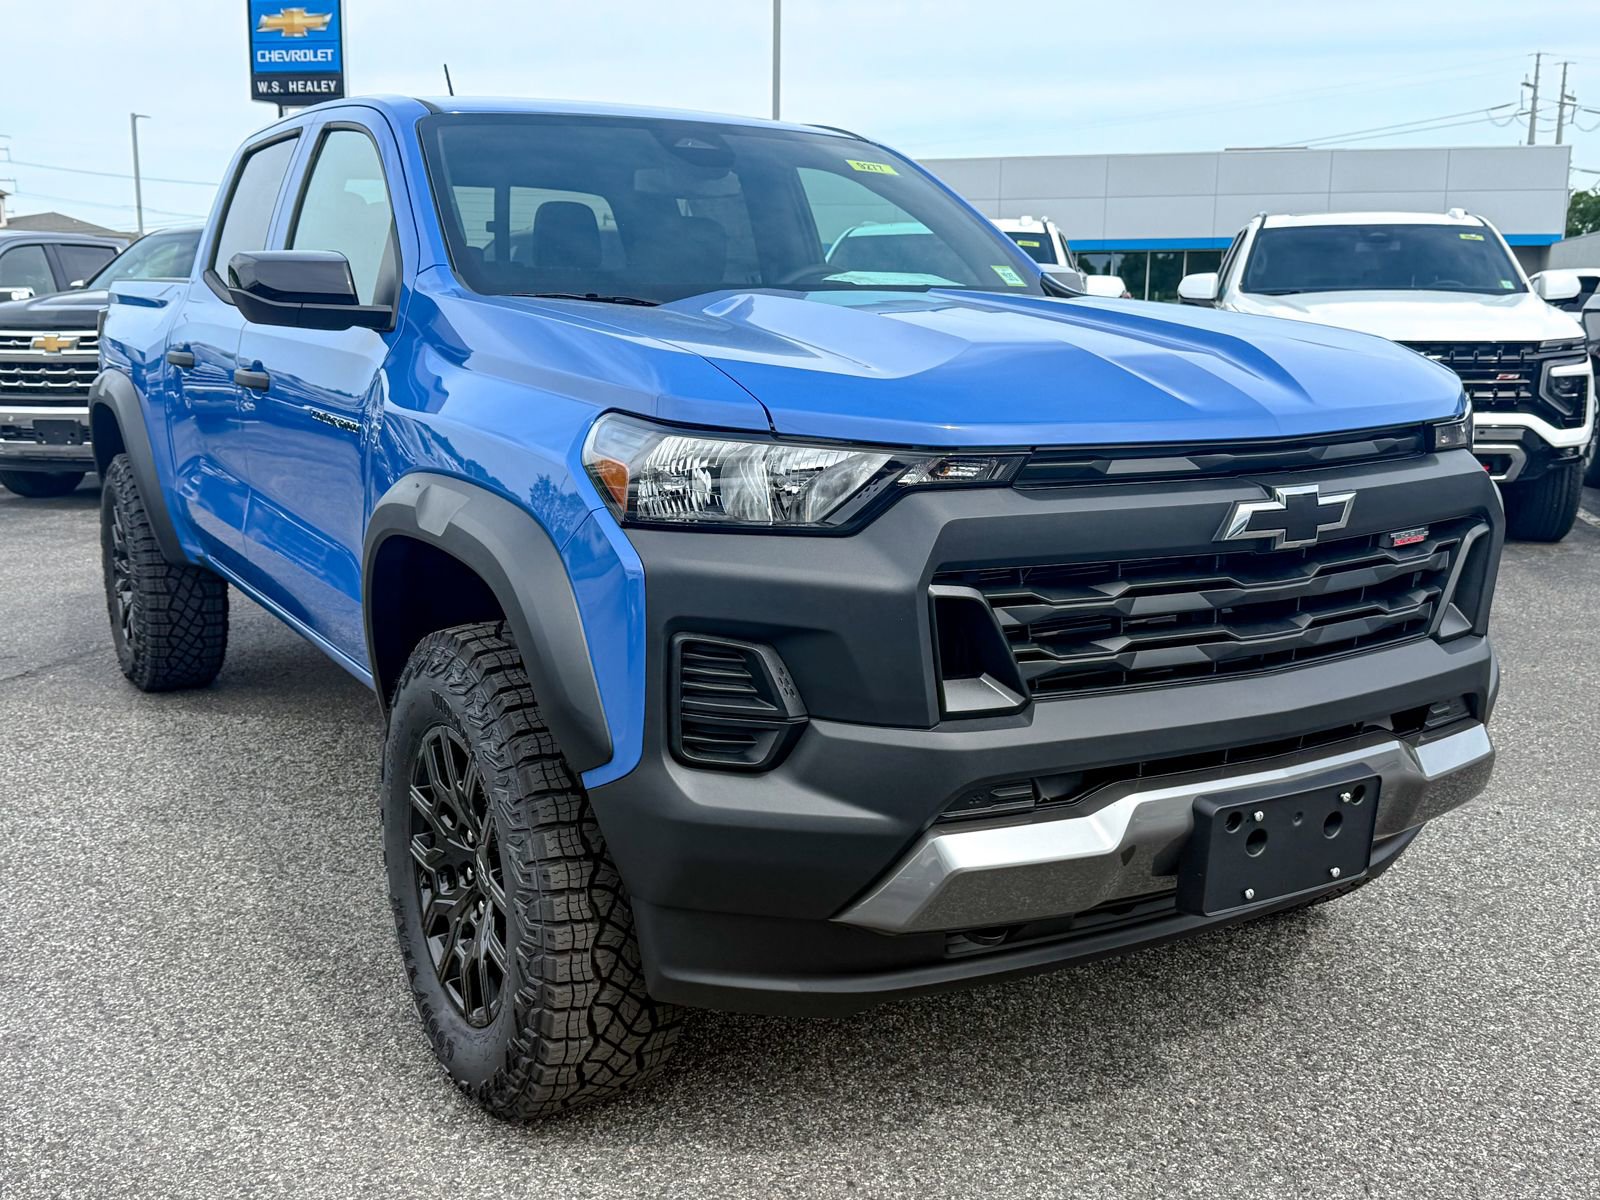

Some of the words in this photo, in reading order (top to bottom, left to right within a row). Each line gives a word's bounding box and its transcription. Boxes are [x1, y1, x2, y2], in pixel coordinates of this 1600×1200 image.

[256, 48, 334, 62] CHEVROLET
[257, 81, 284, 93] W.S.
[288, 80, 336, 93] HEALEY
